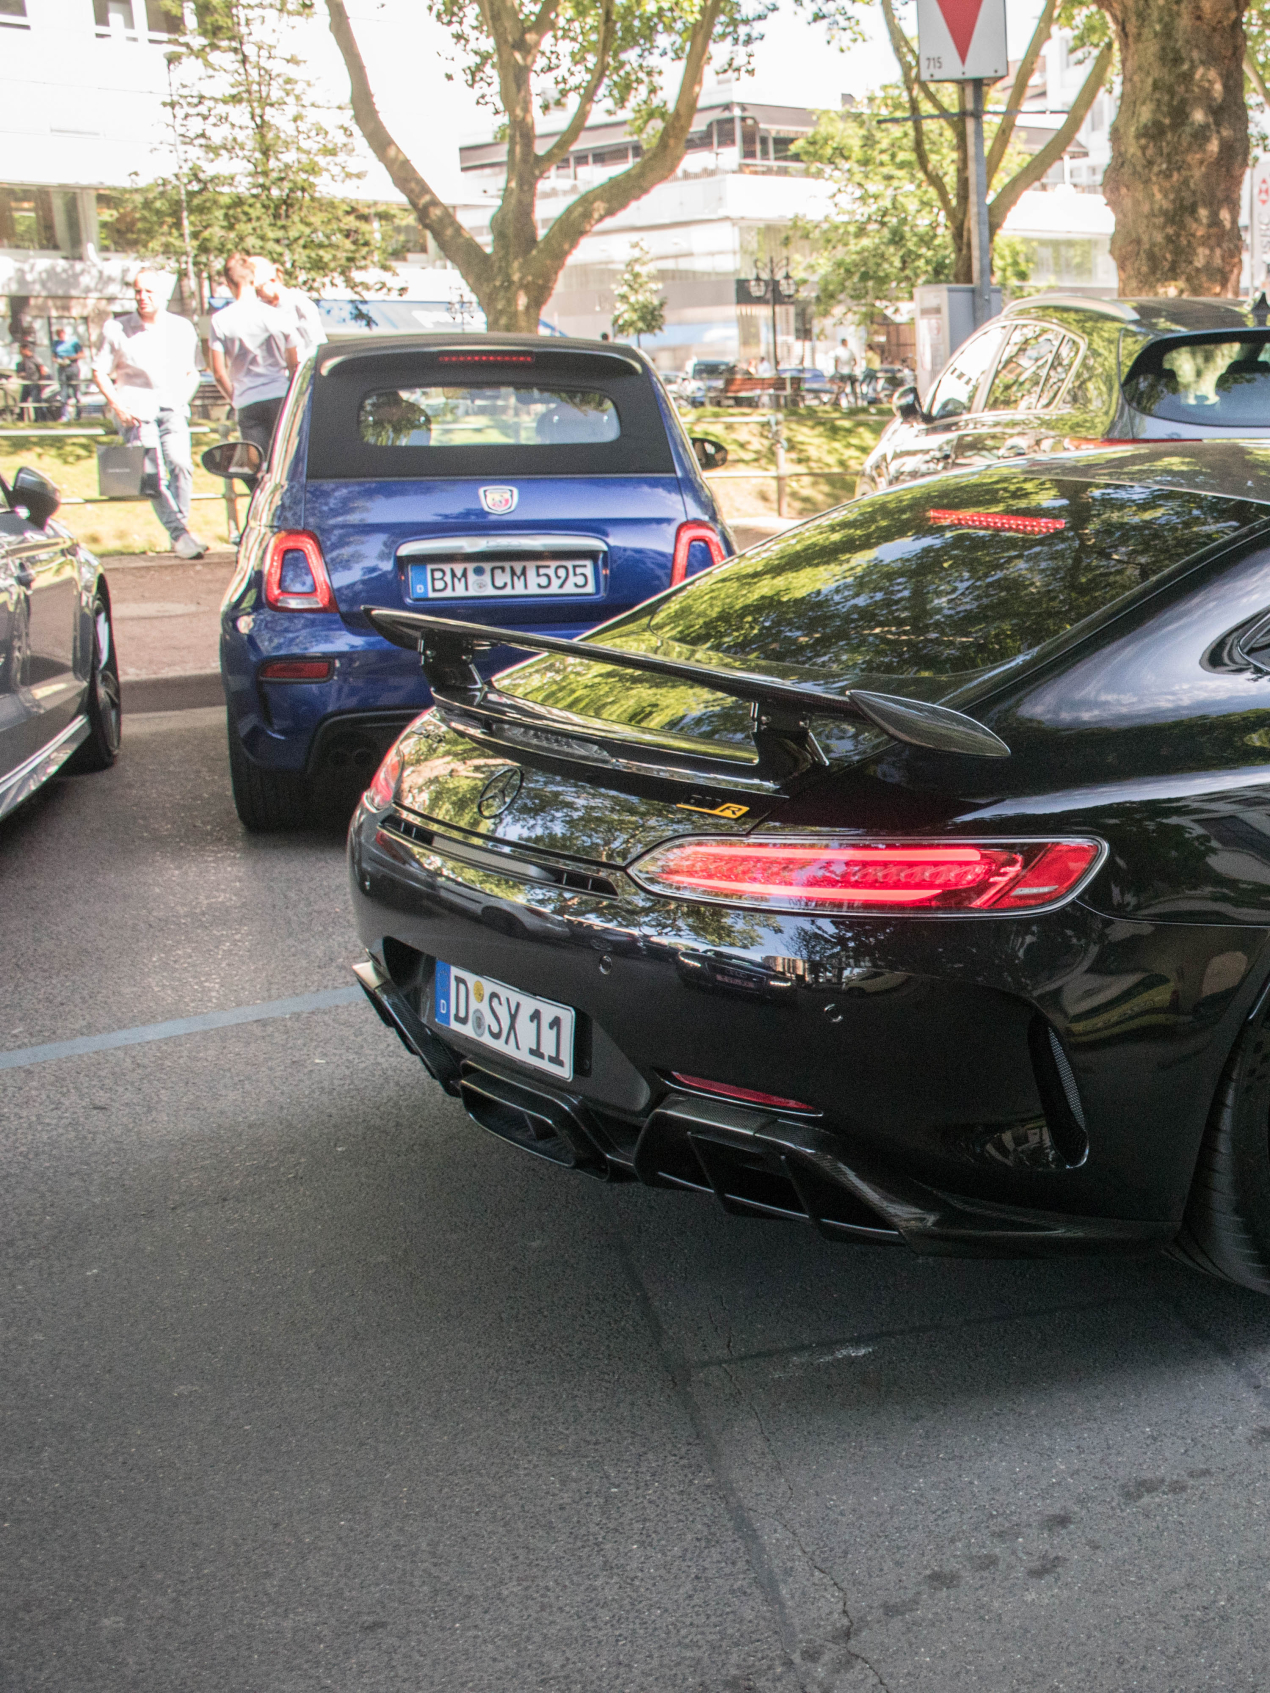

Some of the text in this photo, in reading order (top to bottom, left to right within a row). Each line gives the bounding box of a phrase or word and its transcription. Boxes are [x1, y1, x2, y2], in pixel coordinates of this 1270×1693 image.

[926, 57, 942, 69] 715
[430, 566, 468, 592] BM
[490, 565, 528, 590] CM
[535, 564, 588, 589] 595
[453, 974, 470, 1026] D
[487, 991, 521, 1051] SX
[528, 1008, 565, 1068] 11
